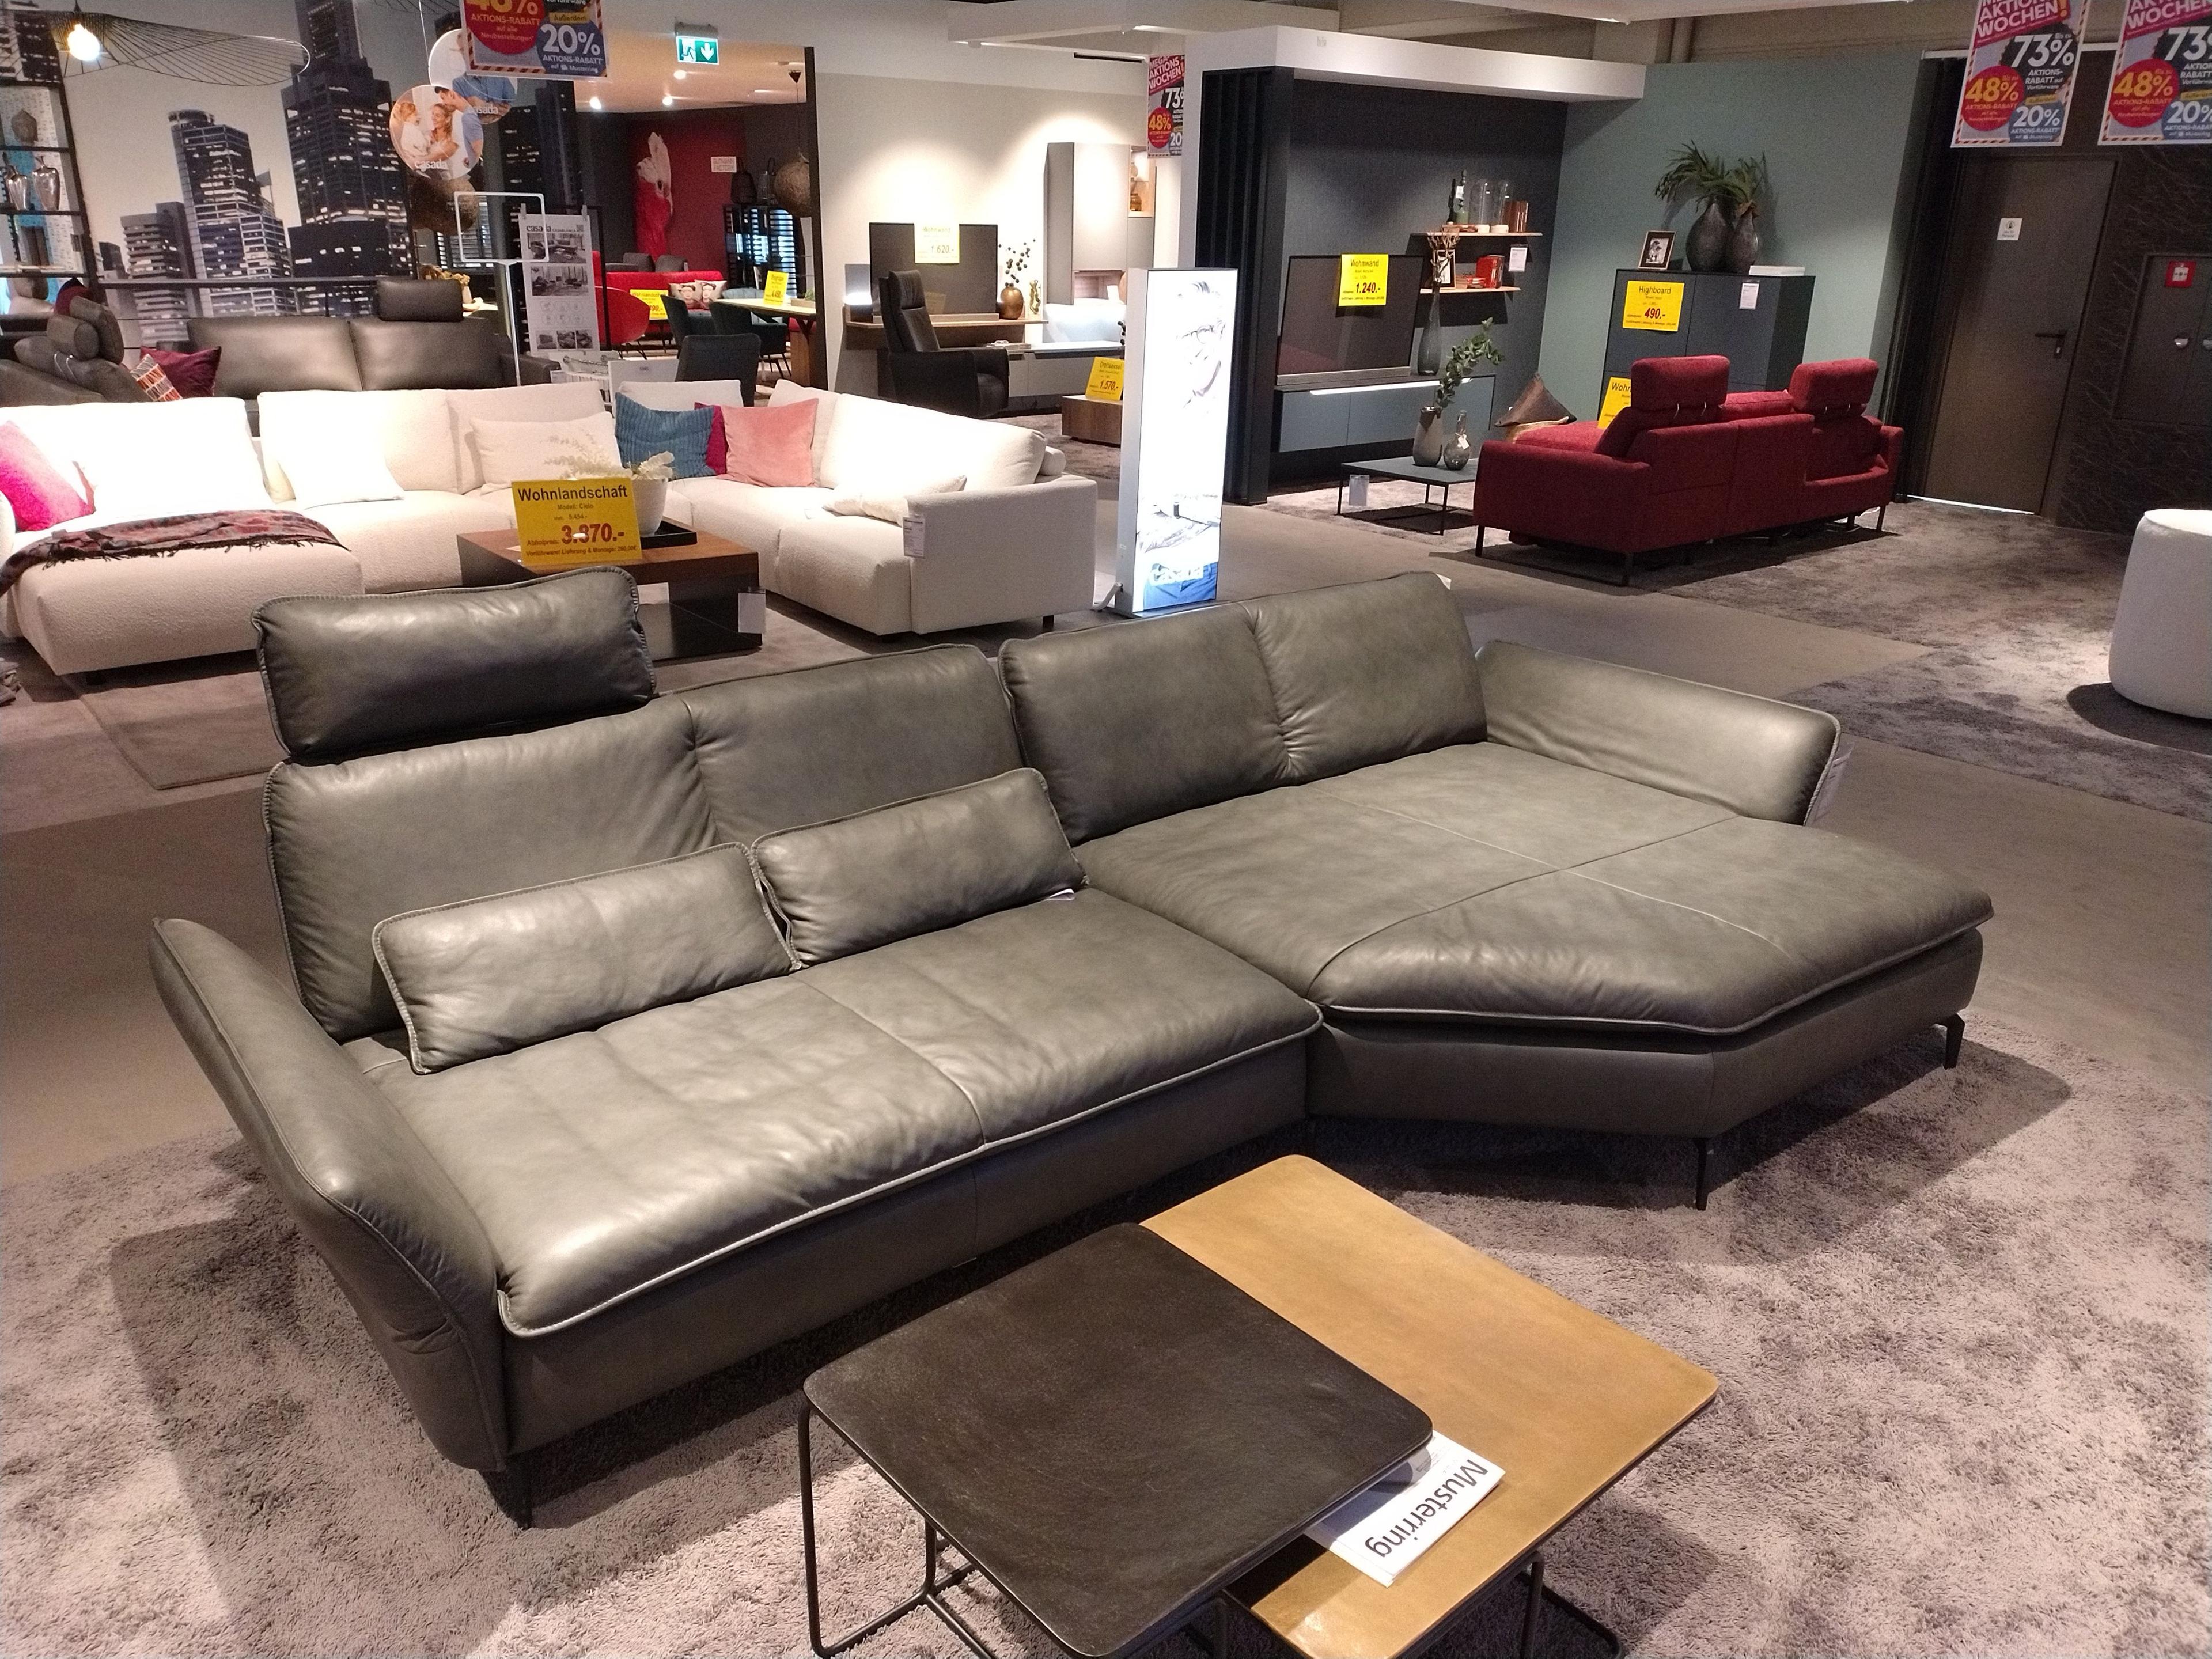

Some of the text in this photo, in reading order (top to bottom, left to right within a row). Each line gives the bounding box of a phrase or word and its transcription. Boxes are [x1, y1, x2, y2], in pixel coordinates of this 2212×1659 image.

[540, 24, 600, 55] 20%
[2011, 33, 2074, 67] 73%
[1149, 56, 1180, 79] AKTIONS
[1965, 77, 2019, 102] 48%
[2113, 71, 2173, 97] 48%
[472, 104, 499, 114] asada
[2013, 105, 2061, 127] 20%
[1149, 115, 1171, 130] 48%
[1356, 282, 1381, 293] 1.240.-
[1639, 286, 1671, 295] Highboard
[1644, 308, 1666, 319] 490.-
[518, 484, 627, 501] Wohnlandschaft
[561, 523, 624, 544] 3.870.-
[1365, 1459, 1488, 1558] Musterring
